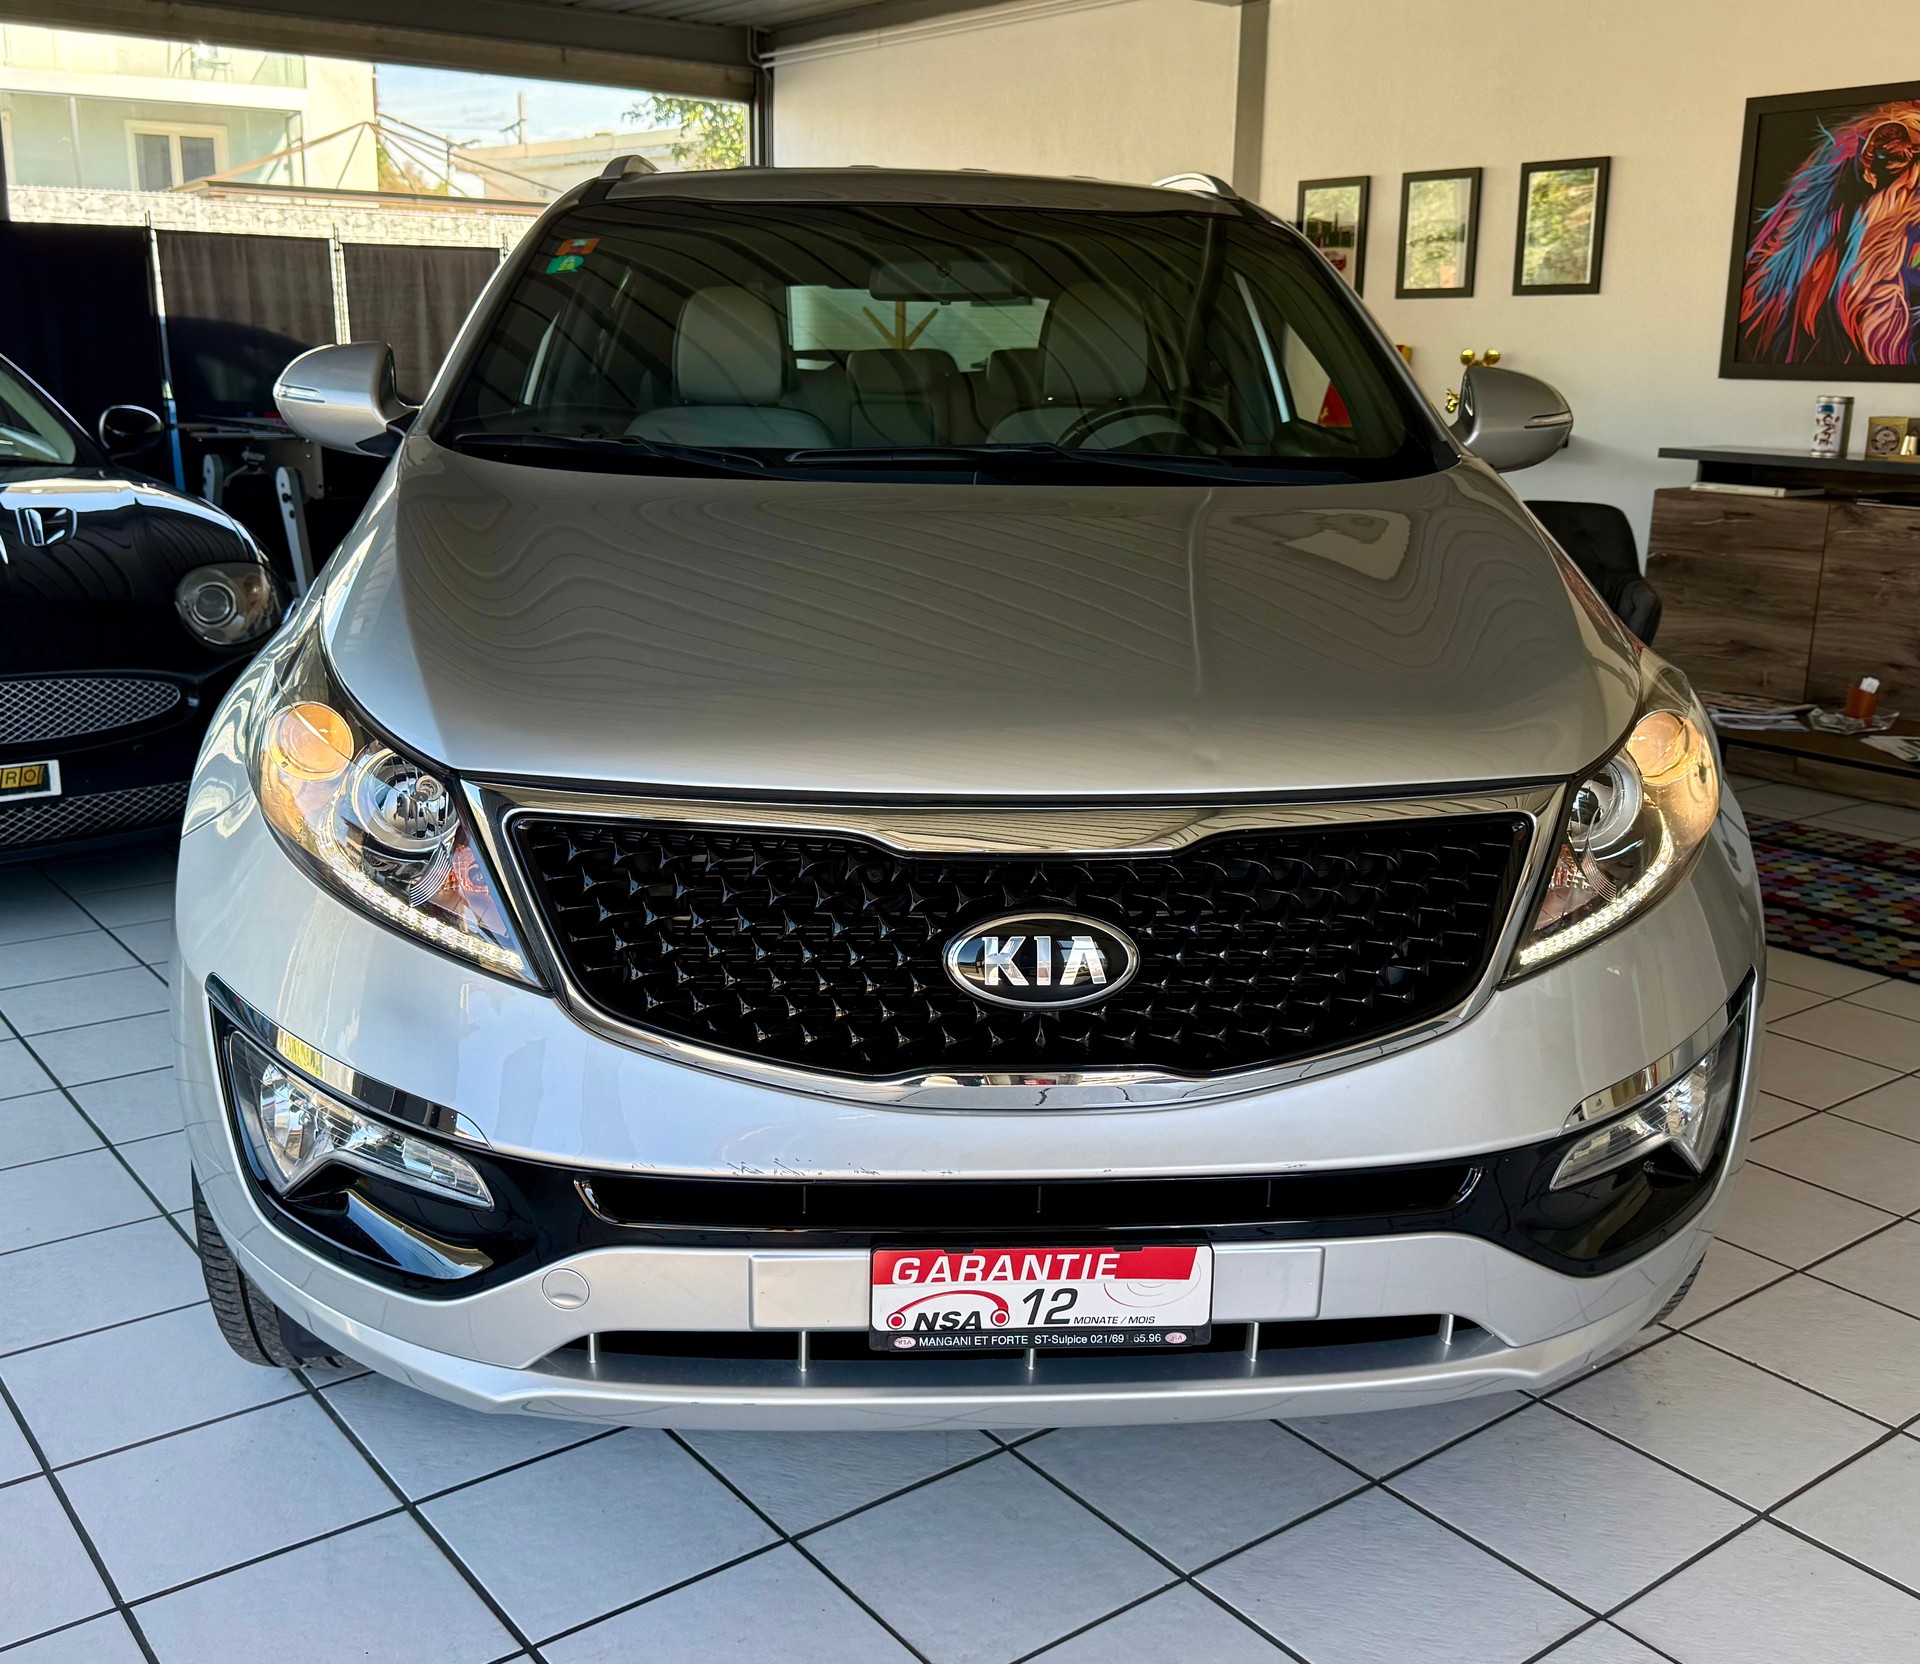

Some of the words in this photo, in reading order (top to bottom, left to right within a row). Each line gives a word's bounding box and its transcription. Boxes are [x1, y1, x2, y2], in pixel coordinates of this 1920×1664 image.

[981, 935, 1107, 986] KIA
[891, 1253, 1120, 1285] GARANTIE
[913, 1311, 983, 1330] NSA
[1022, 1288, 1079, 1325] 12
[1073, 1316, 1119, 1325] MONATE
[1128, 1315, 1156, 1324] MOIS
[919, 1337, 971, 1346] MANGANI
[974, 1336, 989, 1345] ET
[991, 1336, 1029, 1345] FORTE
[1034, 1334, 1088, 1346] ST-Sulpice
